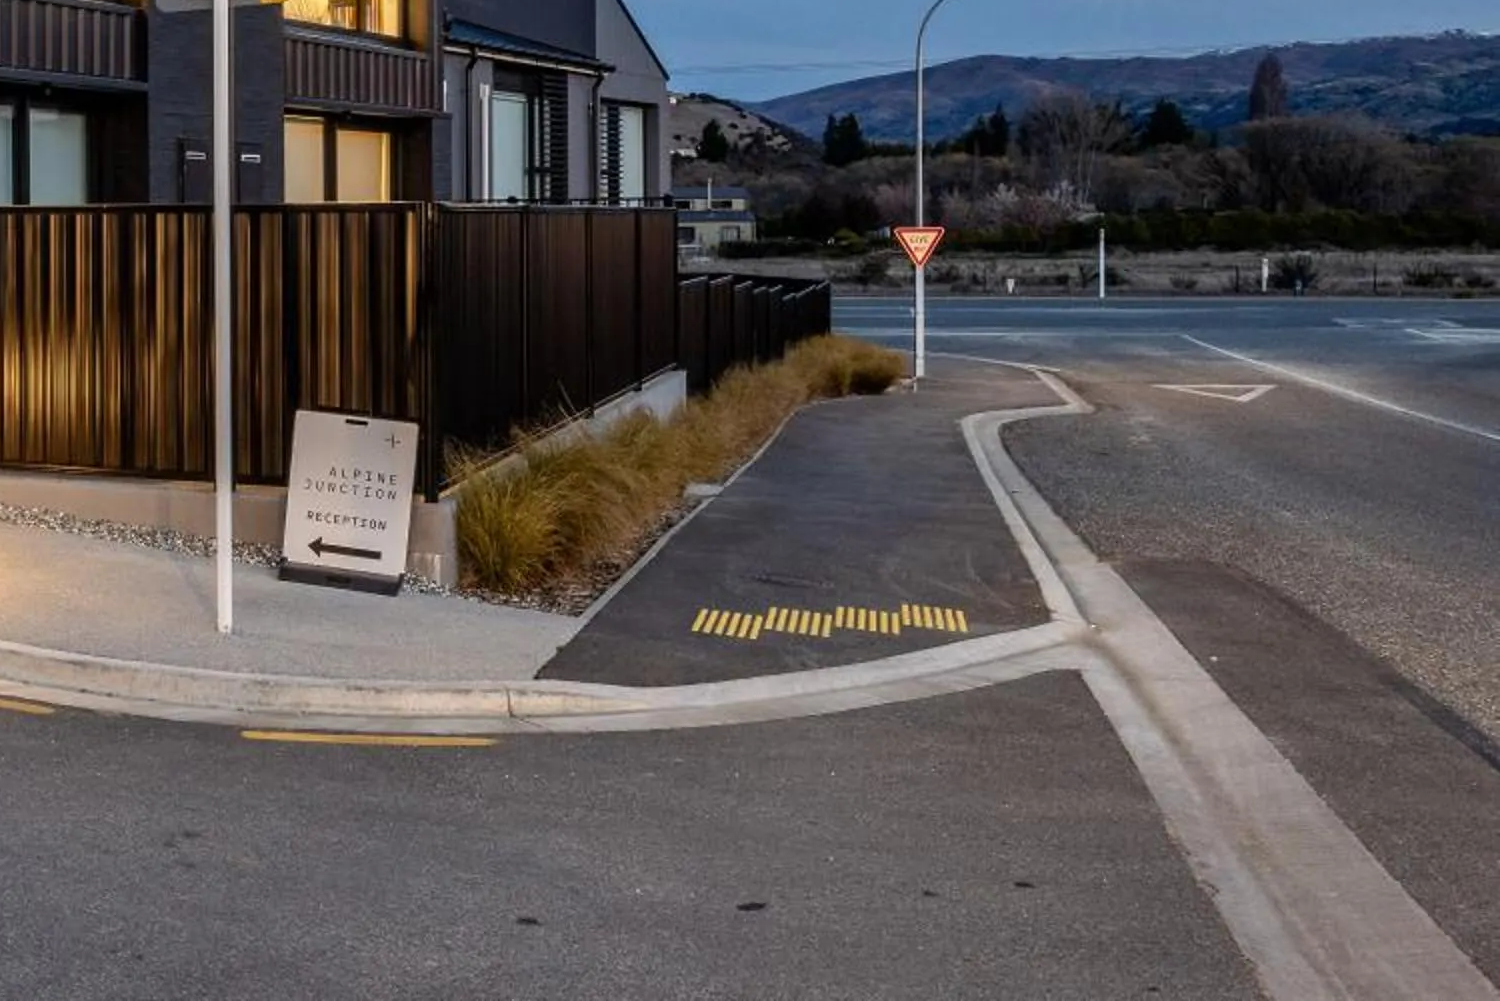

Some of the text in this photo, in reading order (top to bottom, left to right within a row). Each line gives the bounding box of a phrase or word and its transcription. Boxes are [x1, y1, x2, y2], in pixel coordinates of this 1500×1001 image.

[329, 465, 397, 486] ALPINE
[303, 478, 397, 500] JUNCTION
[307, 510, 387, 530] RECEPTION
